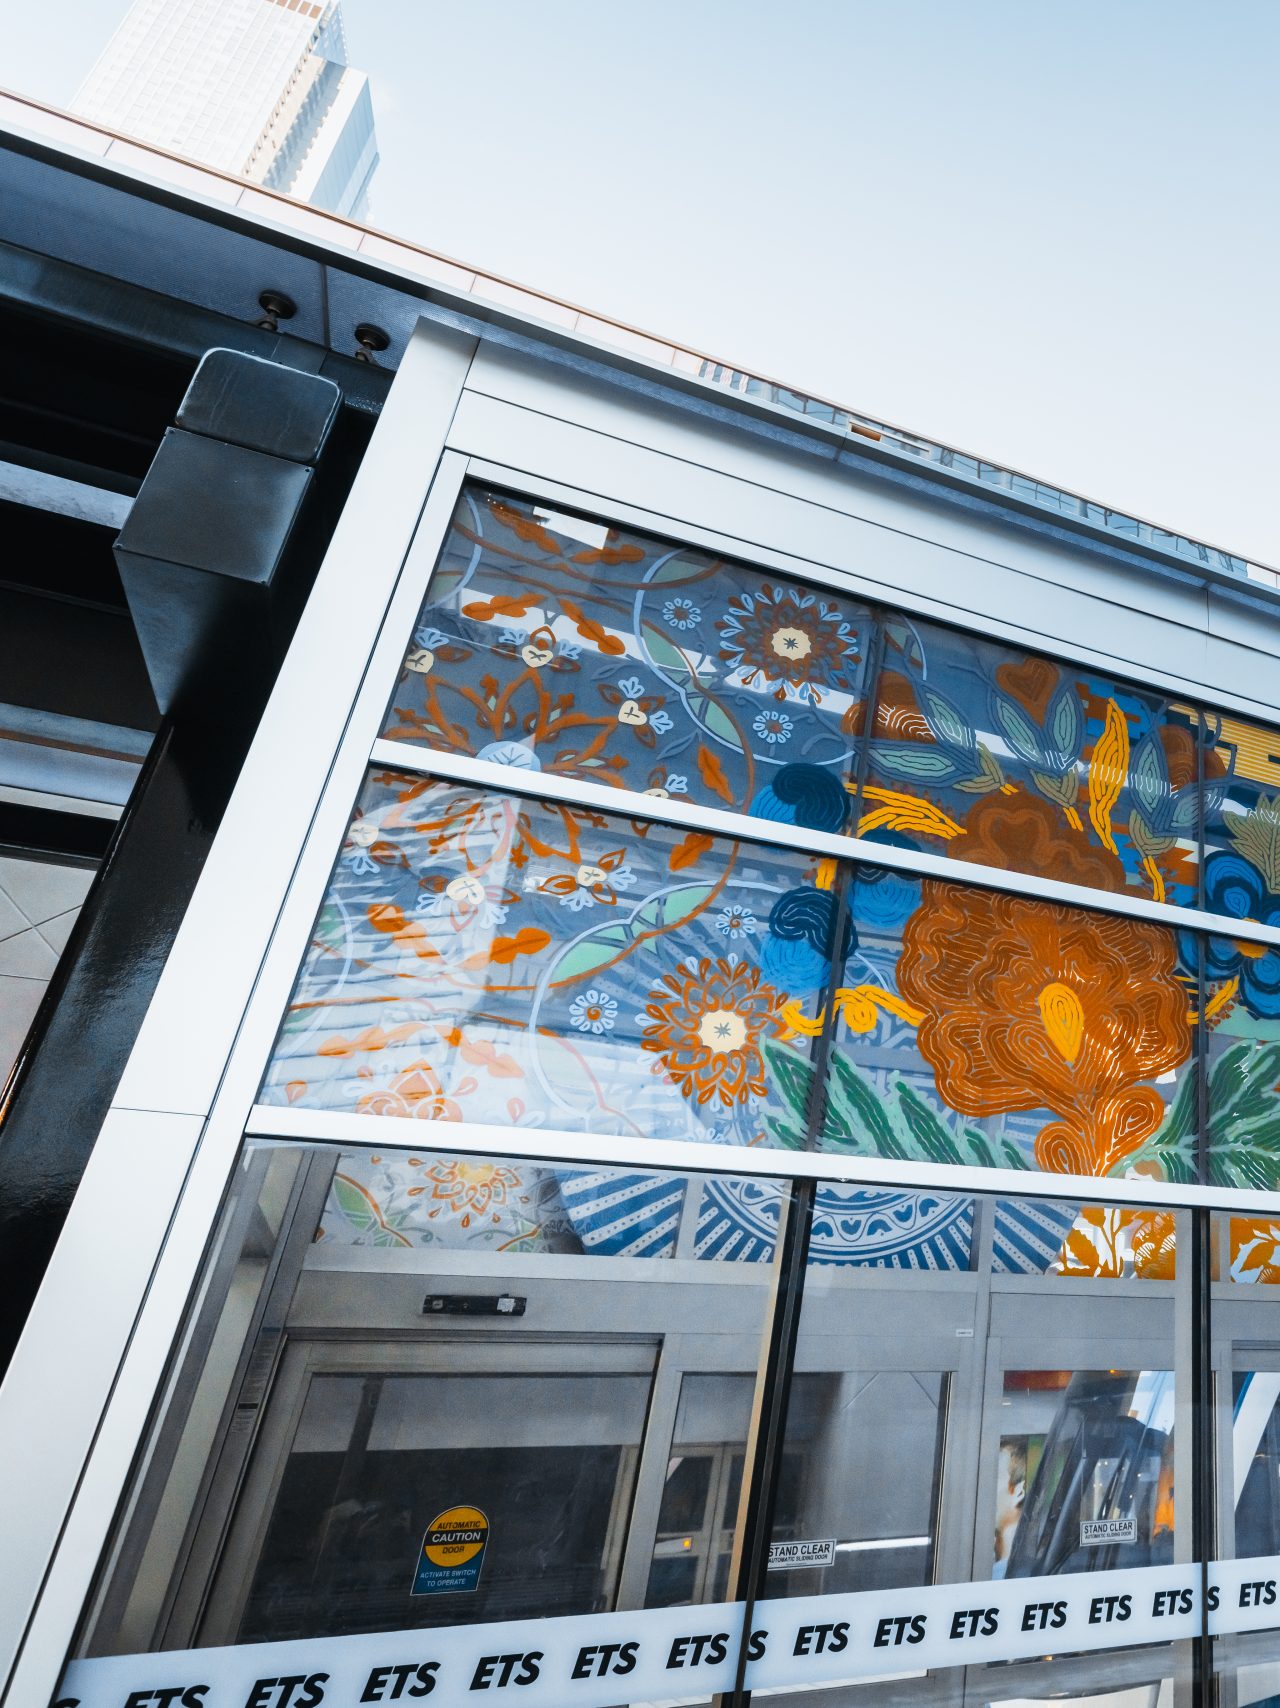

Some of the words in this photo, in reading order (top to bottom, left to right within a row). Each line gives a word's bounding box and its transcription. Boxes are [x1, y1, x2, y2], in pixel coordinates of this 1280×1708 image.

[437, 1520, 481, 1529] AUTOMATIC
[1084, 1524, 1108, 1534] STAND
[1109, 1522, 1133, 1532] CLEAR
[432, 1531, 481, 1543] CAUTION
[442, 1546, 465, 1554] DOOR
[769, 1546, 798, 1557] STAND
[800, 1543, 831, 1555] CLEAR
[451, 1569, 477, 1577] SWITCH
[437, 1578, 466, 1586] OPERATE
[1238, 1580, 1277, 1607] ETS
[793, 1623, 850, 1656] ETS
[874, 1614, 928, 1647] ETS
[950, 1607, 1000, 1639] ETS
[1021, 1600, 1068, 1631] ETS
[1089, 1594, 1133, 1624] ETS
[1152, 1588, 1194, 1617] ETS
[245, 1673, 331, 1708] ETS
[360, 1662, 442, 1703] ETS
[469, 1651, 545, 1691] ETS
[571, 1641, 640, 1680] ETS
[666, 1633, 731, 1669] ETS
